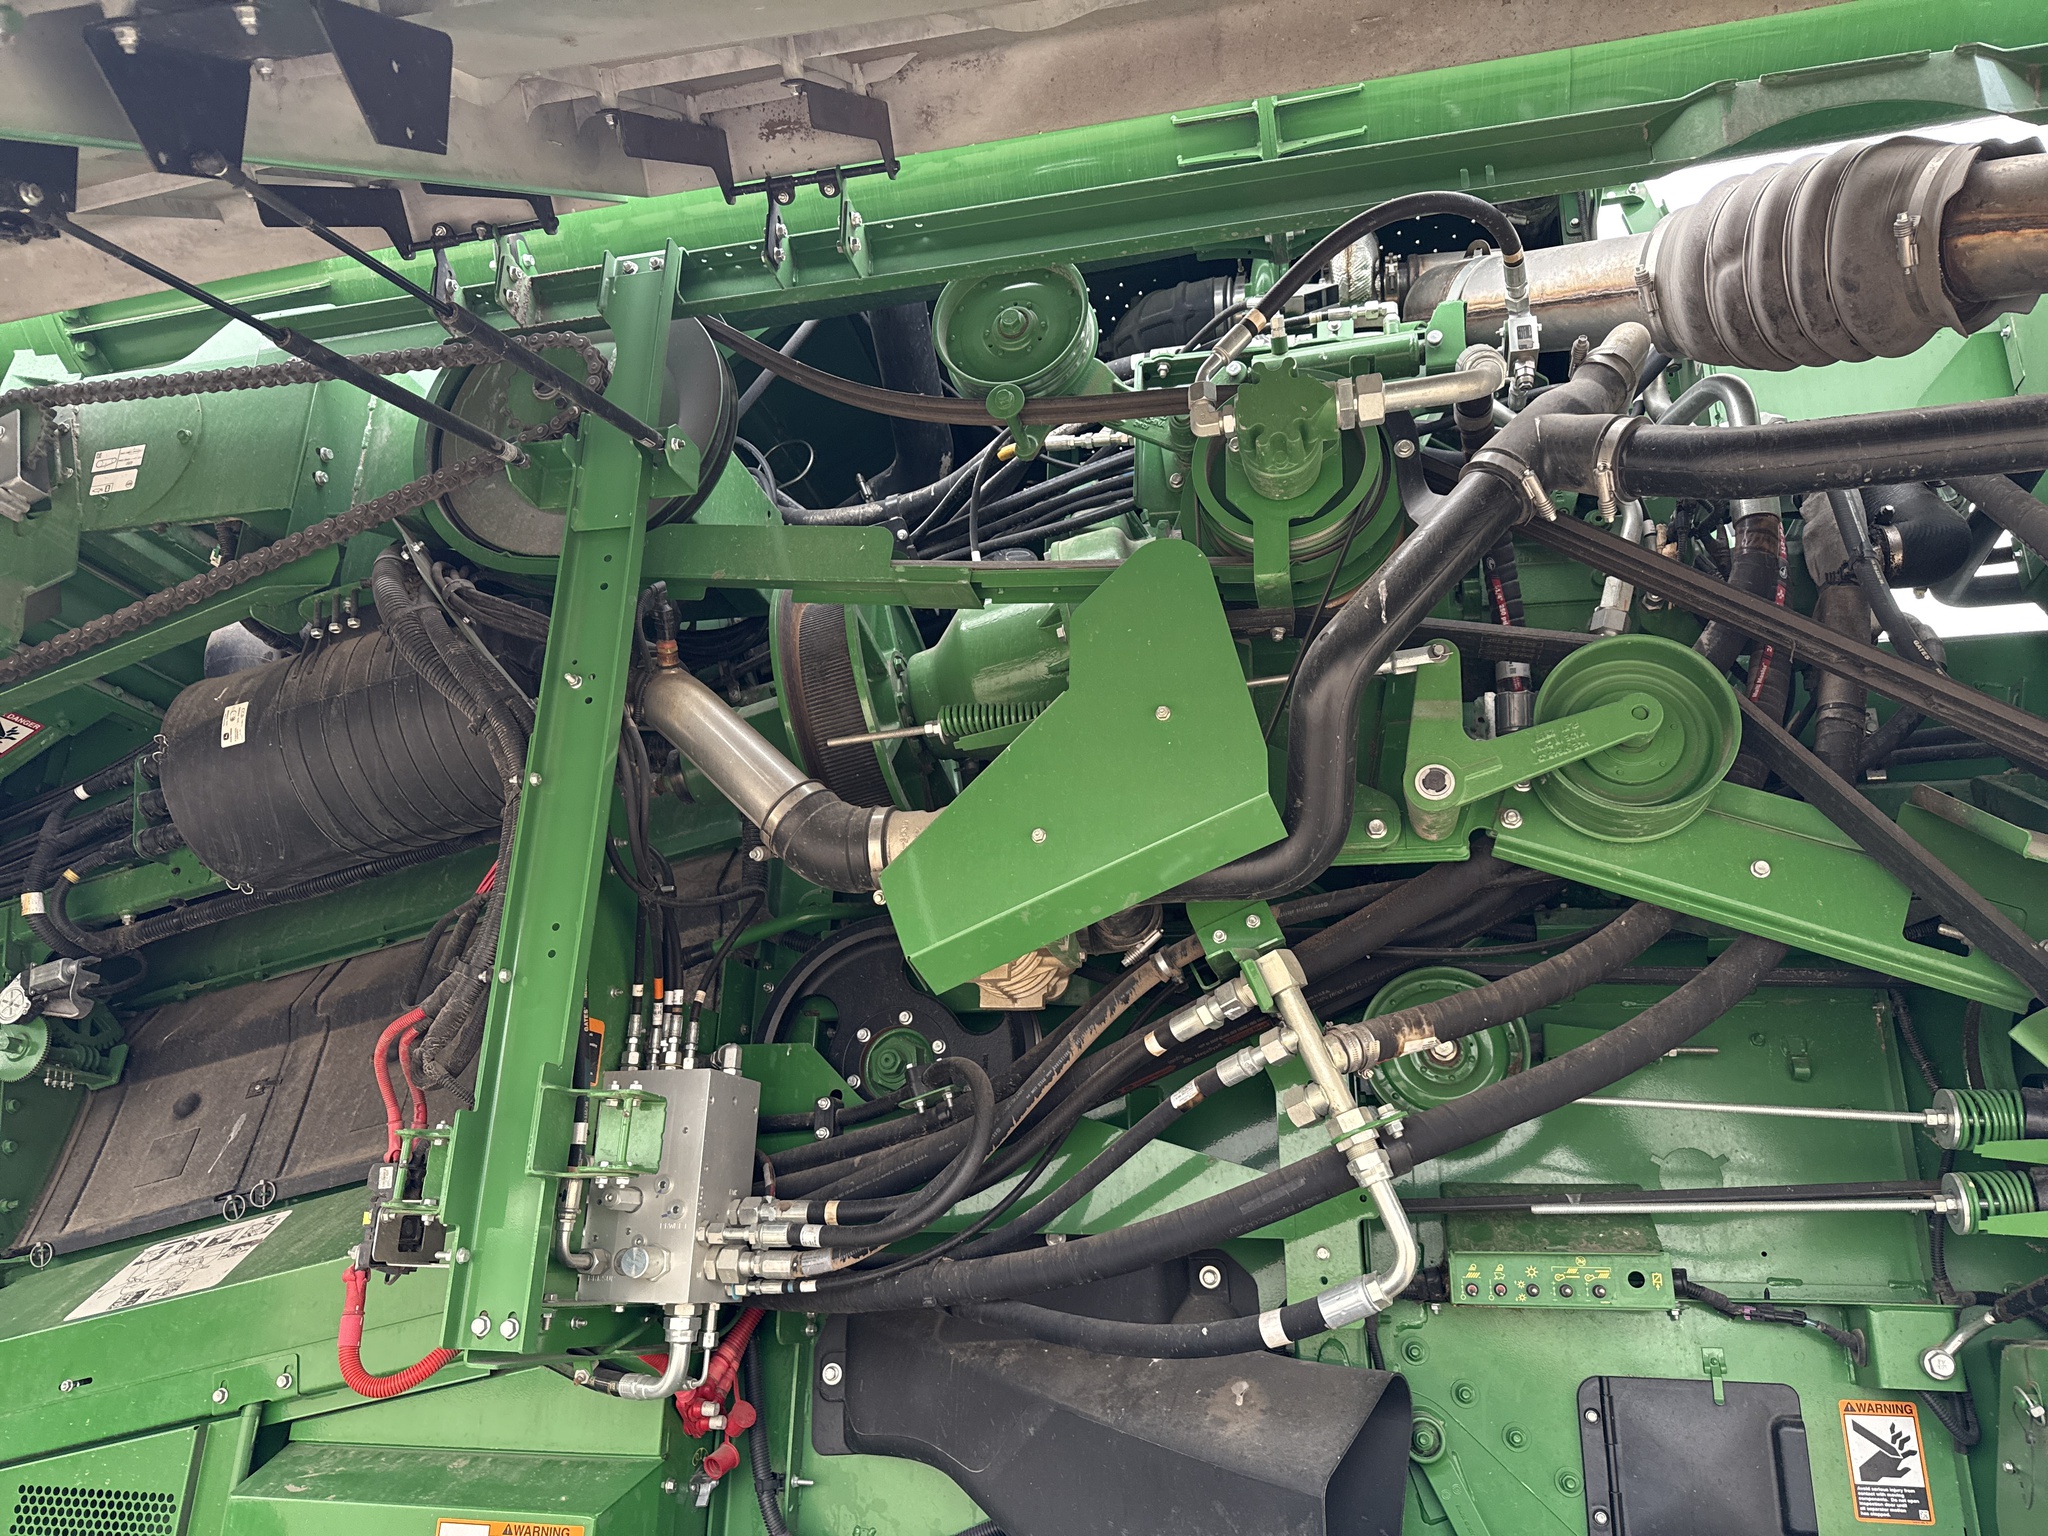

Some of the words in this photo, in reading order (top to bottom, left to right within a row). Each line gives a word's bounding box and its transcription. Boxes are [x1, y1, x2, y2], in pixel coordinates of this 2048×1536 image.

[1913, 640, 1931, 661] GATES
[6, 713, 41, 730] DANGER
[1855, 1403, 1913, 1415] WARNING
[514, 1524, 570, 1536] WARNING
